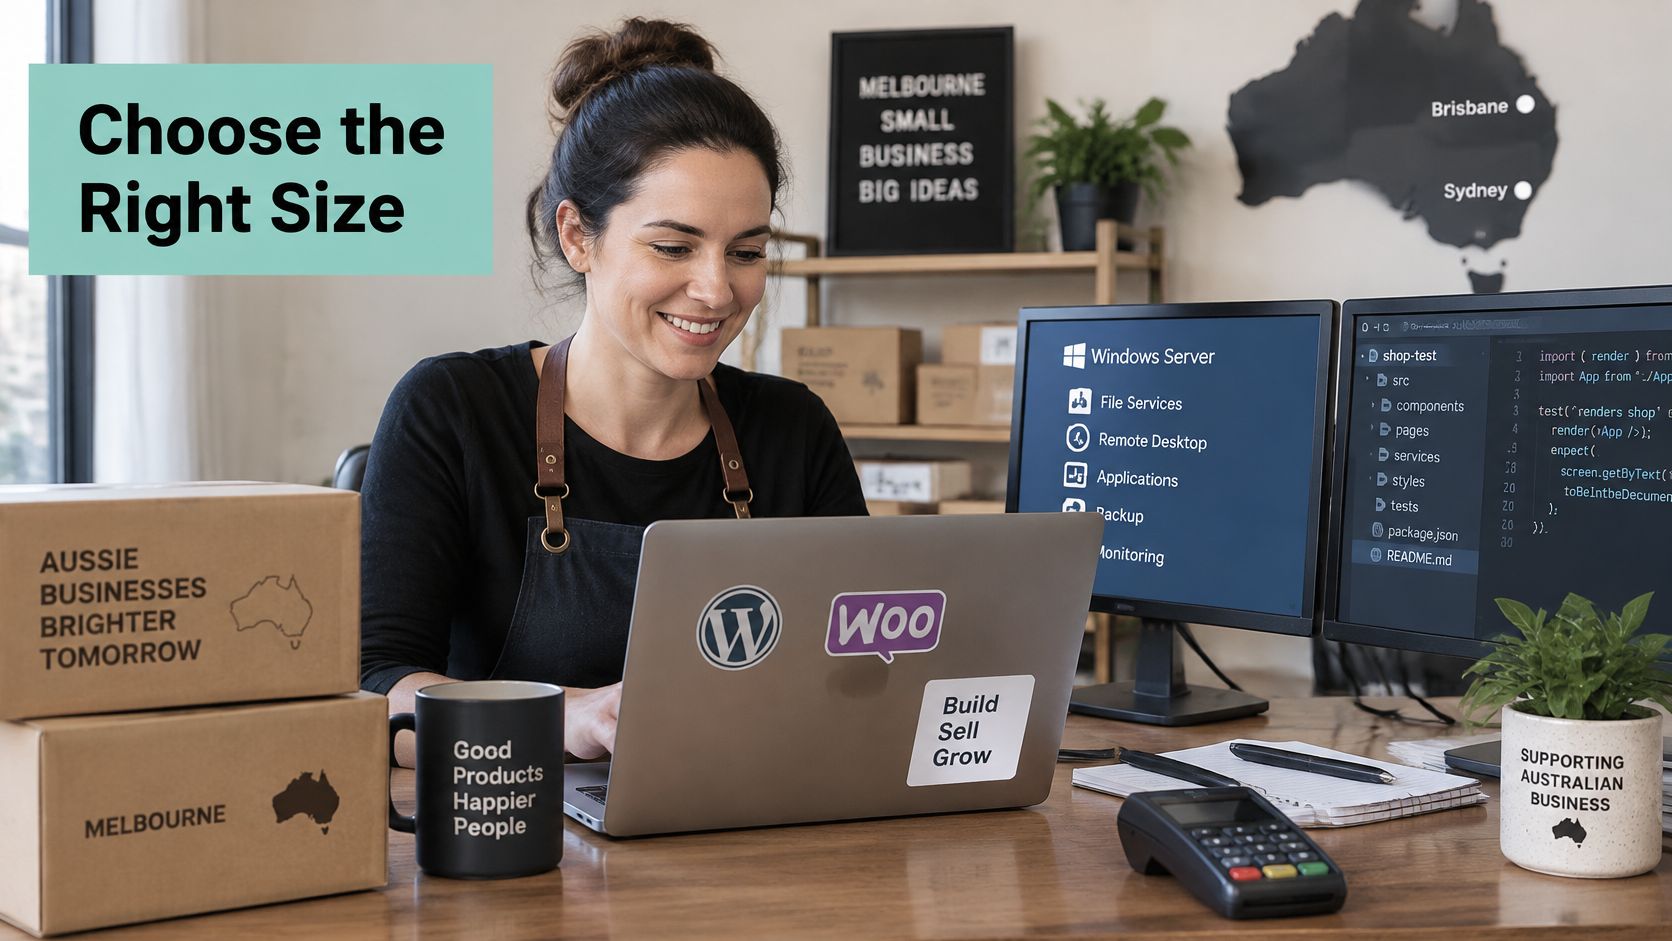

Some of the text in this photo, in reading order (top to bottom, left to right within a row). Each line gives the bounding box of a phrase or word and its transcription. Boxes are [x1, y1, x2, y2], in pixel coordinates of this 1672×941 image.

[859, 73, 986, 98] MELBOURNE
[1432, 100, 1508, 117] Brisbane
[880, 108, 955, 133] SMALL
[859, 142, 974, 168] BUSINESS
[859, 177, 979, 203] BIG IDEAS
[1444, 182, 1508, 202] Sydney
[1091, 347, 1215, 365] Windows Server
[1383, 349, 1437, 364] shop-test
[1539, 350, 1575, 363] import
[1592, 350, 1629, 361] render
[1392, 376, 1410, 387] src
[1539, 371, 1575, 384] import
[1579, 371, 1599, 384] App
[1604, 370, 1632, 381] from
[1101, 395, 1183, 411] File Services
[1396, 400, 1465, 415] components
[1099, 432, 1208, 452] Remote Desktop
[1396, 426, 1429, 439] pages
[1394, 450, 1440, 463] services
[1097, 469, 1179, 487] Applications
[1392, 475, 1425, 489] styles
[1391, 500, 1419, 512] tests
[1388, 526, 1459, 543] package.json
[40, 548, 138, 573] AUSSIE
[1387, 549, 1452, 566] README.md
[40, 577, 207, 606] BUSINESSES
[40, 609, 176, 638] BRIGHTER
[40, 639, 202, 670] TOMORROW
[943, 694, 999, 715] Build
[938, 721, 979, 741] Sell
[453, 740, 511, 760] Good
[933, 748, 992, 767] Grow
[1521, 748, 1624, 770] SUPPORTING
[453, 765, 544, 785] Products
[1521, 769, 1623, 791] AUSTRALIAN
[453, 791, 536, 815] Happier
[1530, 791, 1610, 812] BUSINESS
[84, 804, 226, 839] MELBOURNE
[453, 816, 527, 840] People
